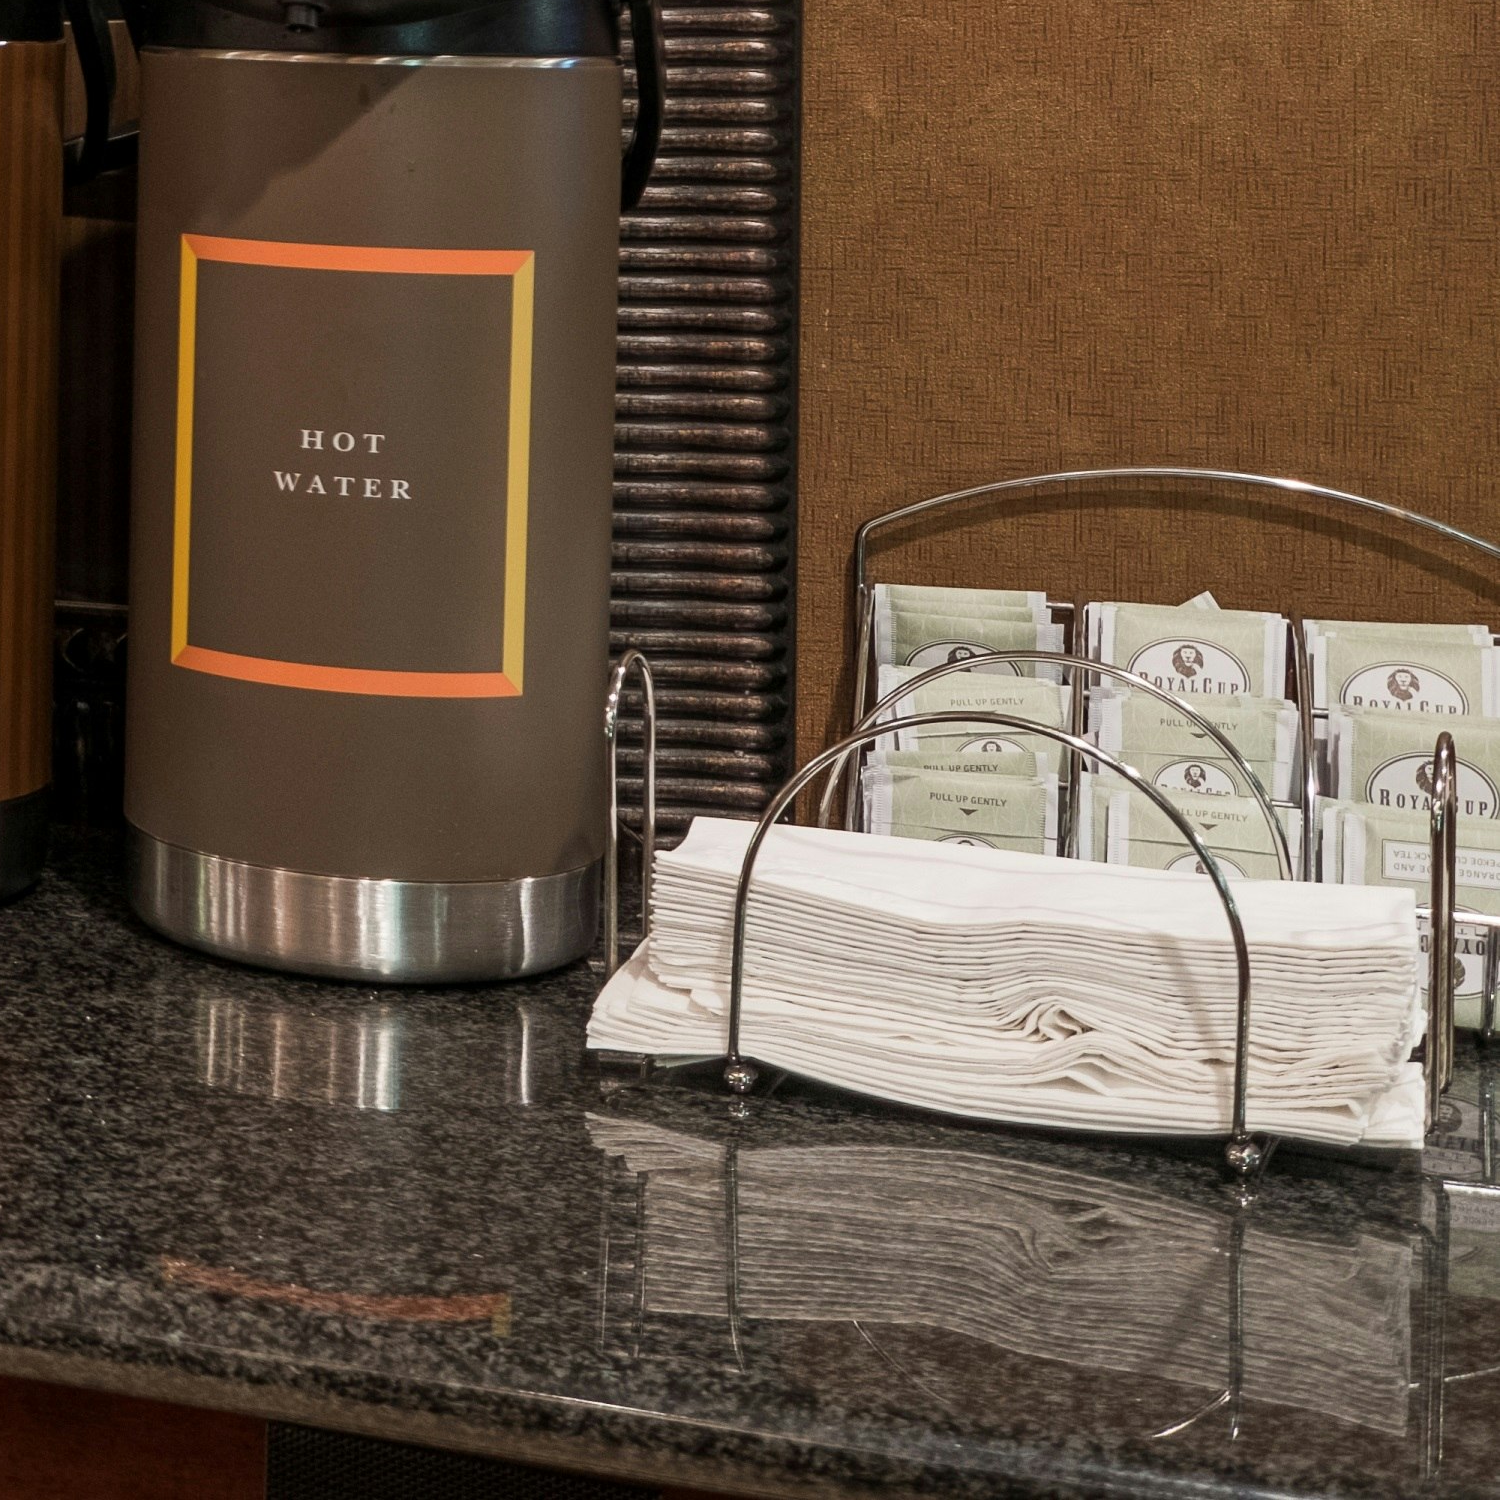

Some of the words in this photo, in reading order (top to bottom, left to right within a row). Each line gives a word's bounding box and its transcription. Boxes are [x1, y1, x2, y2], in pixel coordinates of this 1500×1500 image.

[300, 429, 385, 453] HOT
[273, 470, 412, 499] WATER
[950, 698, 973, 707] PULL
[990, 697, 1024, 706] GENTLY
[1160, 718, 1184, 727] PULL
[964, 764, 999, 772] GENTLY
[929, 792, 953, 802] PULL
[955, 795, 969, 803] UP
[971, 796, 1007, 807] GENTLY
[1195, 810, 1208, 818] UP
[1211, 811, 1248, 823] GENTLY
[1393, 850, 1411, 859] TEA
[1393, 863, 1415, 872] AND
